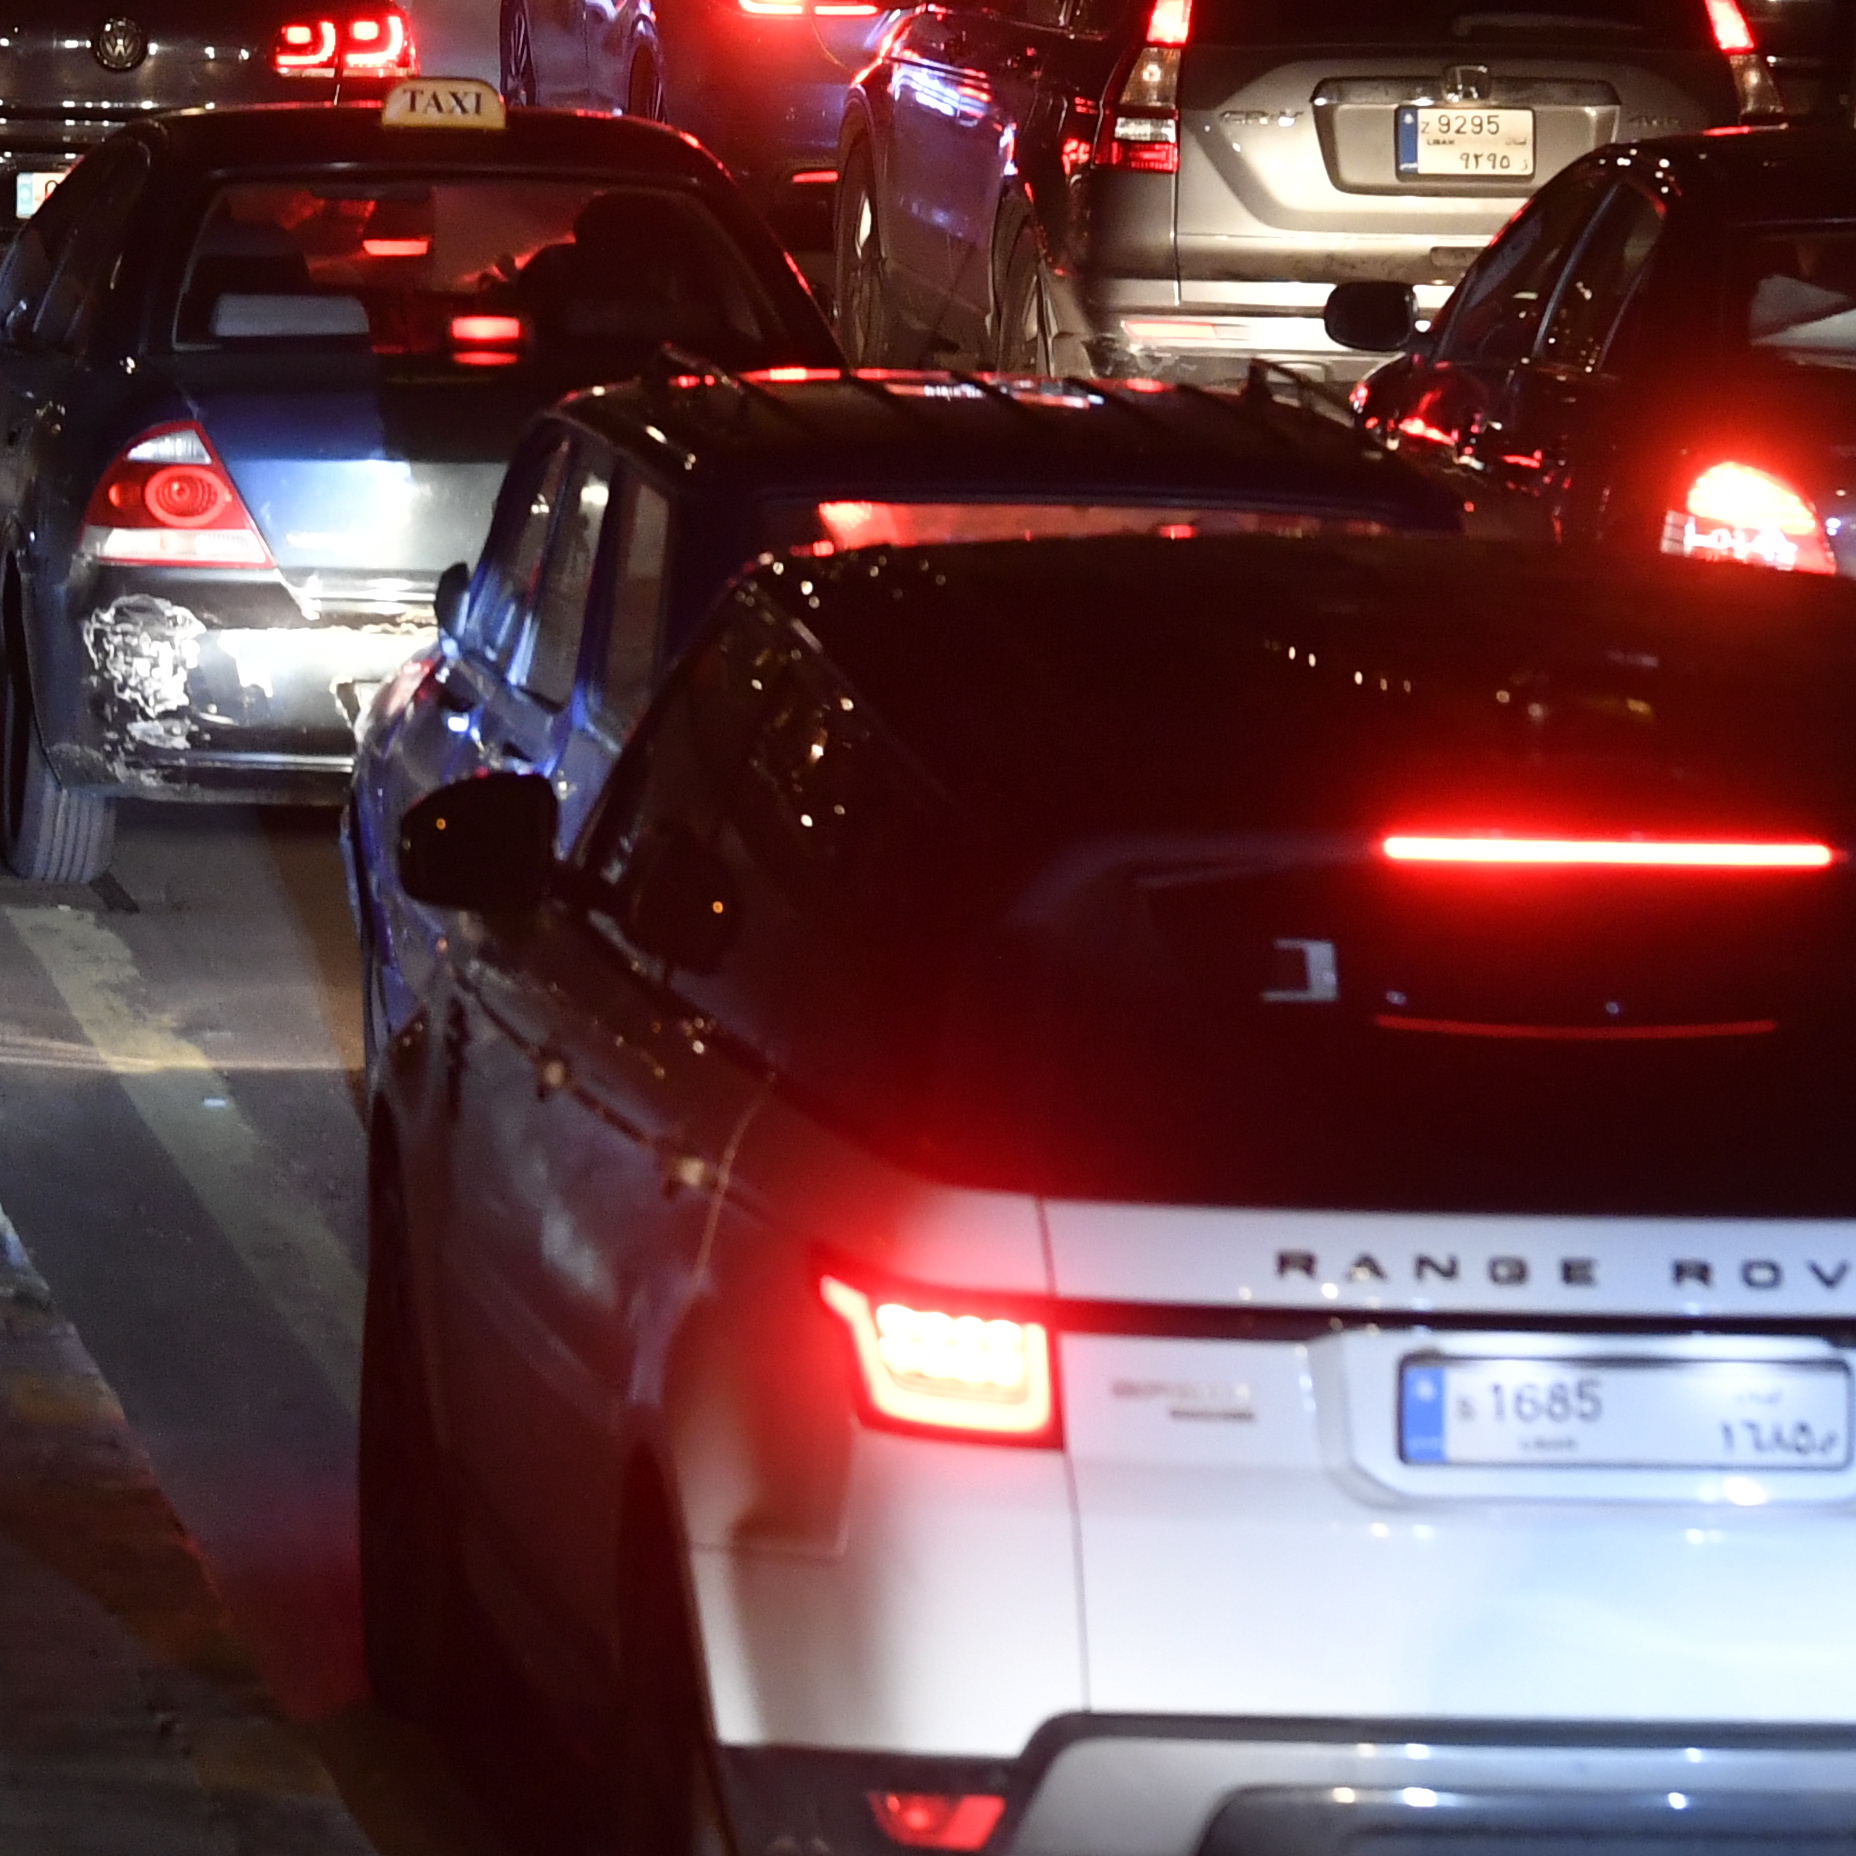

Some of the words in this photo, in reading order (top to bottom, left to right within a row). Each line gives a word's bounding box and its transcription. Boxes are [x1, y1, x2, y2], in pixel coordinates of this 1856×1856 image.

[403, 89, 482, 115] TAXI
[1437, 114, 1501, 136] 9295
[1459, 152, 1511, 170] ٩٢٩٥
[1275, 1251, 1599, 1287] RANGE
[1490, 1380, 1604, 1423] 1685
